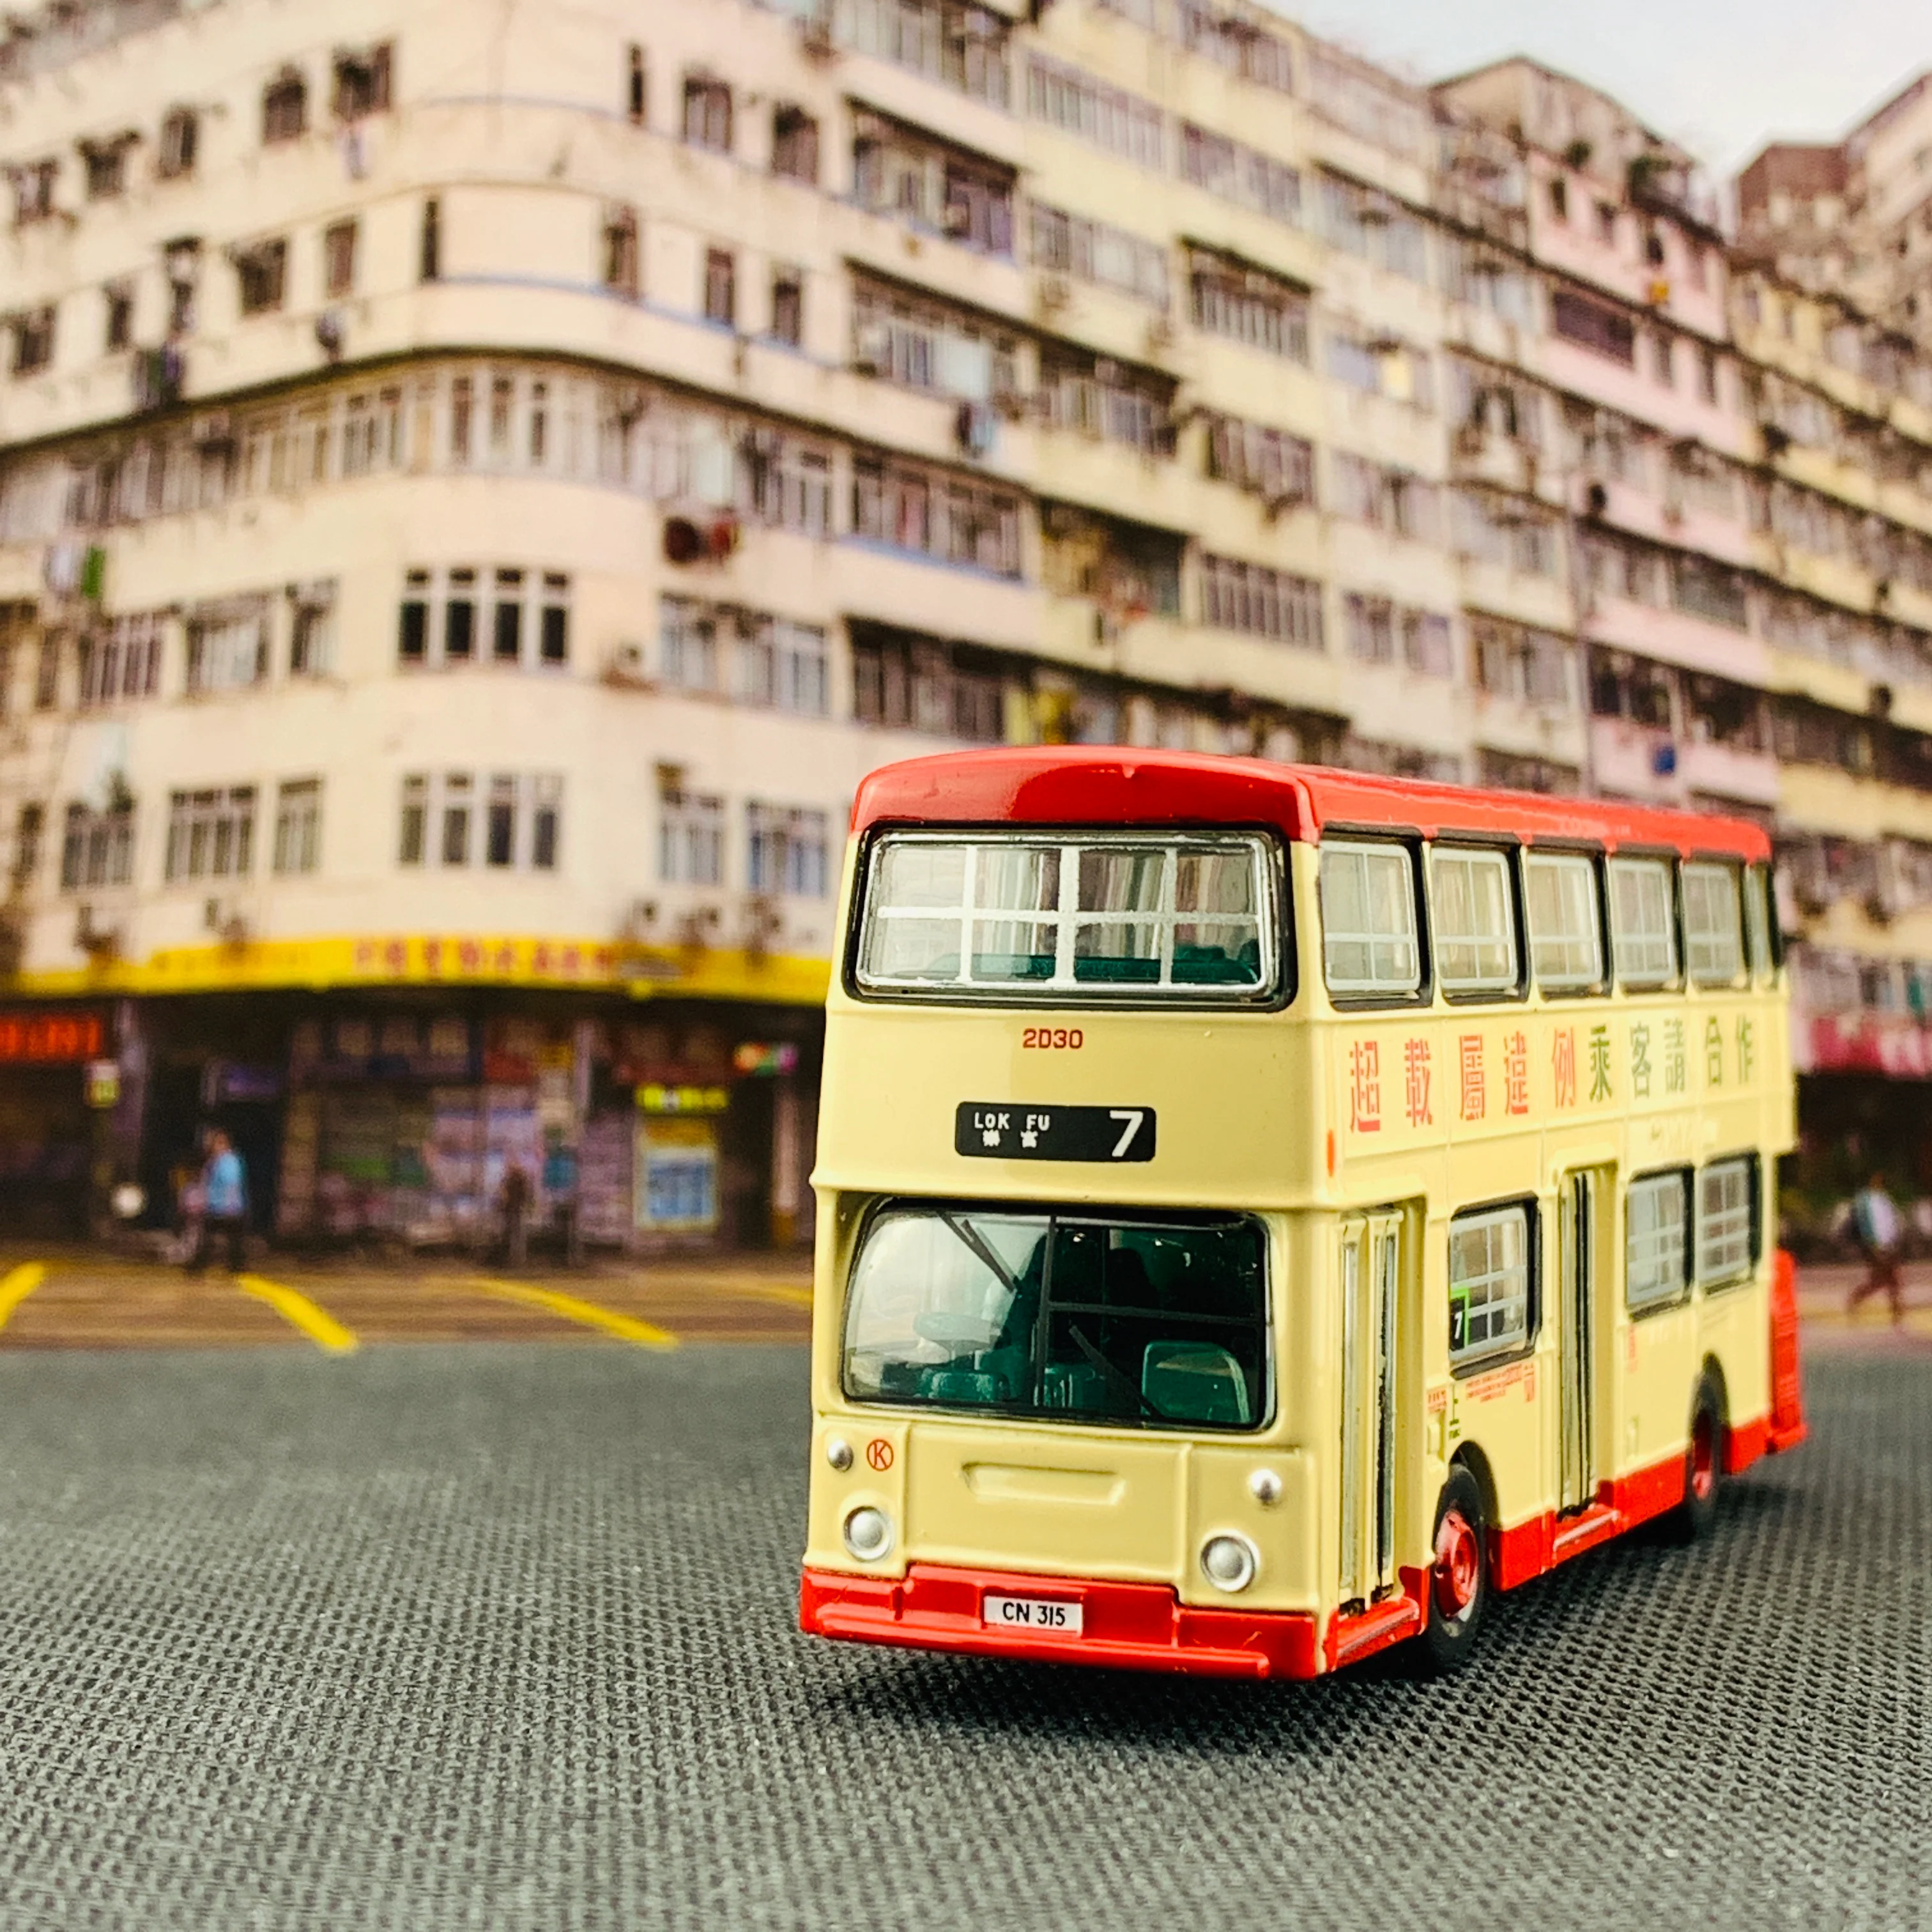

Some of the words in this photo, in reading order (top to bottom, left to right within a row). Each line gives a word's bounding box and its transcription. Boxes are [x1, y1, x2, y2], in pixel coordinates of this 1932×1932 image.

[1022, 1028, 1084, 1049] 2D30
[974, 1112, 1010, 1130] LOK
[1026, 1114, 1050, 1131] FU
[1109, 1110, 1144, 1158] 7
[1002, 1602, 1030, 1623] CN
[1038, 1605, 1066, 1626] 315
